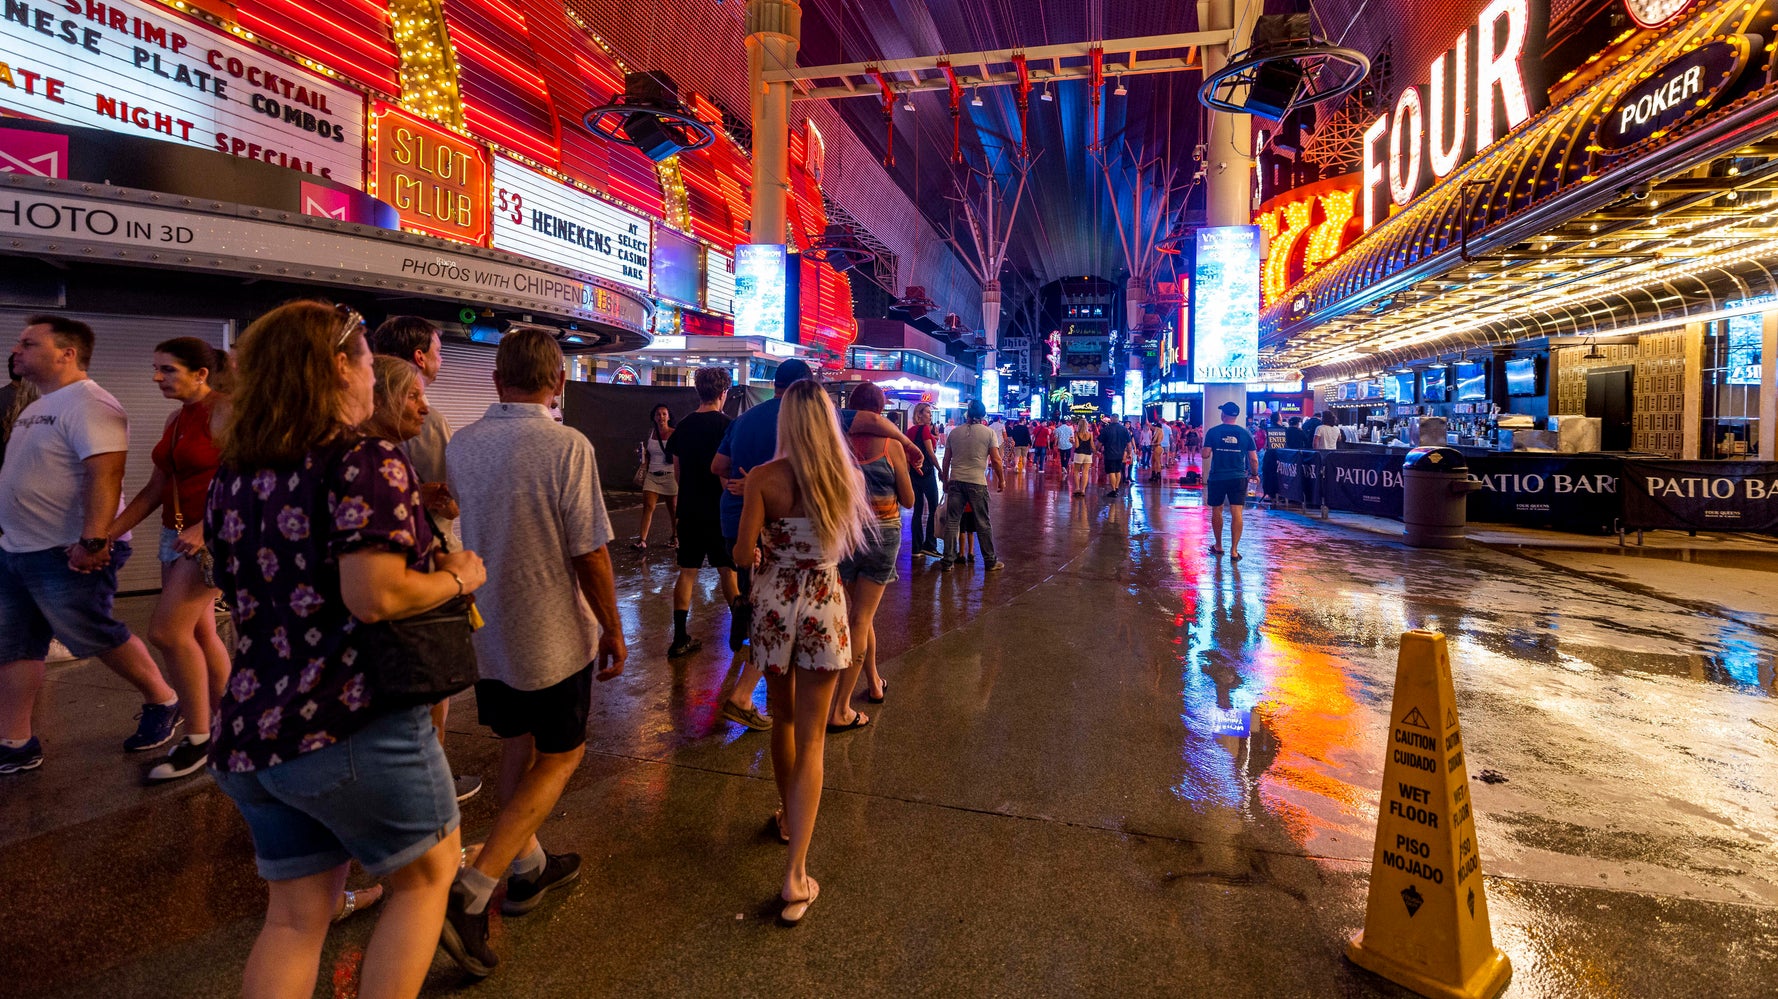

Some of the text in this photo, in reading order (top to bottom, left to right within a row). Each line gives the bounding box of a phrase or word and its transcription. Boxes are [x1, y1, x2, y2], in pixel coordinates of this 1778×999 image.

[63, 0, 332, 115] SHRIMP COCKTAIL
[5, 0, 345, 143] NESE PLATE COMBOS
[1619, 65, 1706, 134] POKER
[96, 93, 194, 142] NIGHT
[1362, 0, 1531, 232] FOUR
[392, 127, 472, 186] SLOT
[392, 173, 471, 227] CLUB
[126, 220, 152, 240] IN
[160, 224, 195, 244] 3D
[532, 208, 612, 256] HEINEKENS
[628, 222, 639, 236] AT
[617, 233, 648, 254] SELECT
[618, 249, 647, 268] CASINO
[622, 264, 643, 281] BARS
[401, 258, 471, 283] PHOTOS
[474, 270, 511, 290] WITH
[513, 272, 613, 314] CHIPPENDALES
[618, 373, 633, 382] PRIME
[1198, 366, 1258, 379] SHAKIRA
[1335, 466, 1379, 487] PATIO
[1382, 470, 1404, 488] BA
[1646, 476, 1736, 499] PATIO
[1394, 728, 1436, 752] CAUTION
[1393, 749, 1437, 774] CUIDADO
[1398, 782, 1432, 806] WET
[1453, 784, 1465, 806] WET
[1389, 800, 1439, 829] FLOOR
[1452, 803, 1470, 830] FLOOR
[1396, 834, 1431, 860] PISO
[1382, 850, 1444, 885] MOJADO
